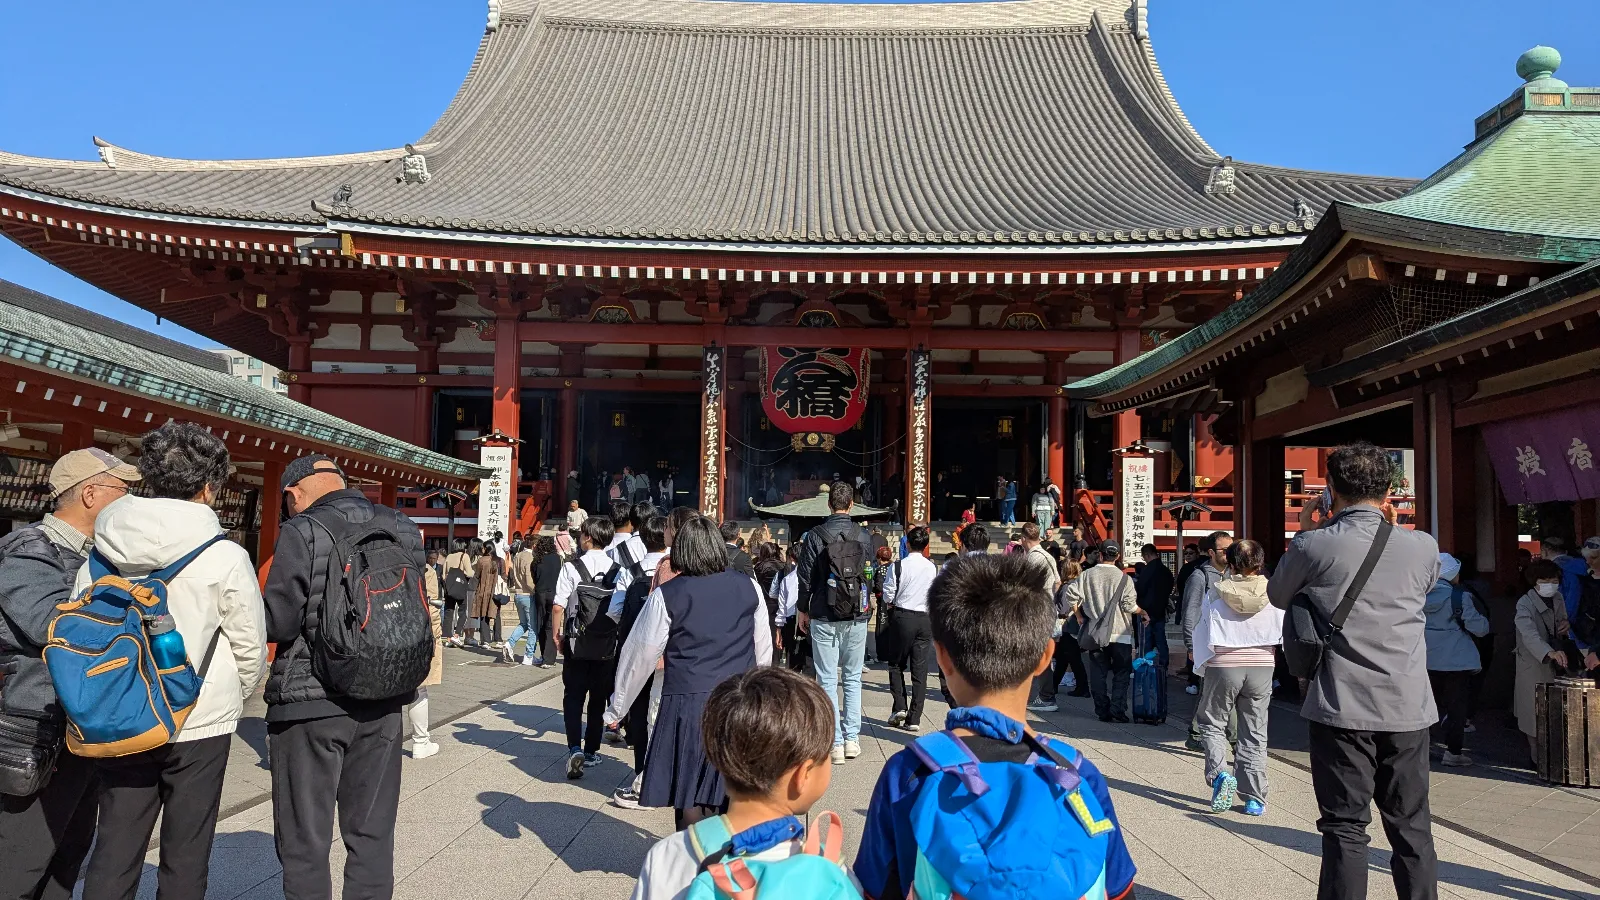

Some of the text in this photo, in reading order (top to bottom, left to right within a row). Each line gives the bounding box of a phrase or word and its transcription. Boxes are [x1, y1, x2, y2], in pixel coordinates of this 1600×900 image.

[1133, 475, 1145, 499] 七五三
[1065, 791, 1115, 838] L
